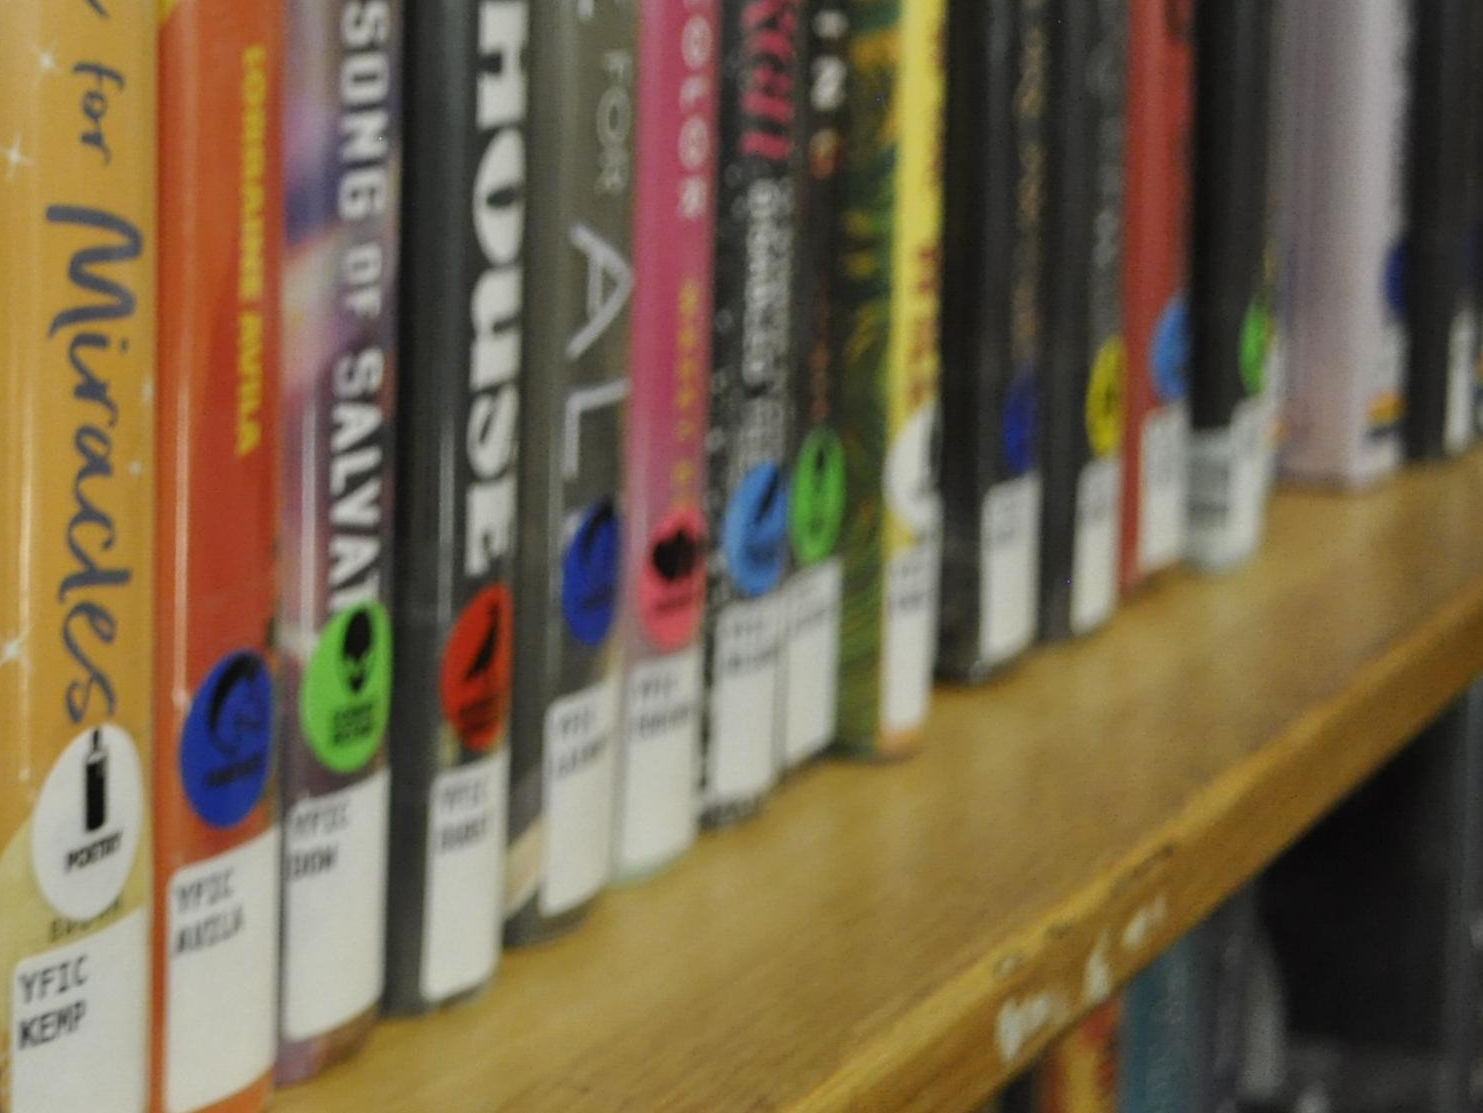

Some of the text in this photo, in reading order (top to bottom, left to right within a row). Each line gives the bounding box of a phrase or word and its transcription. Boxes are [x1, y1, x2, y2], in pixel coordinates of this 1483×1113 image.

[72, 57, 125, 168] for
[340, 242, 384, 321] OF
[44, 201, 145, 726] Miracles
[64, 830, 124, 874] POETRY
[17, 951, 88, 1006] YFIC
[17, 996, 87, 1051] KEMP
